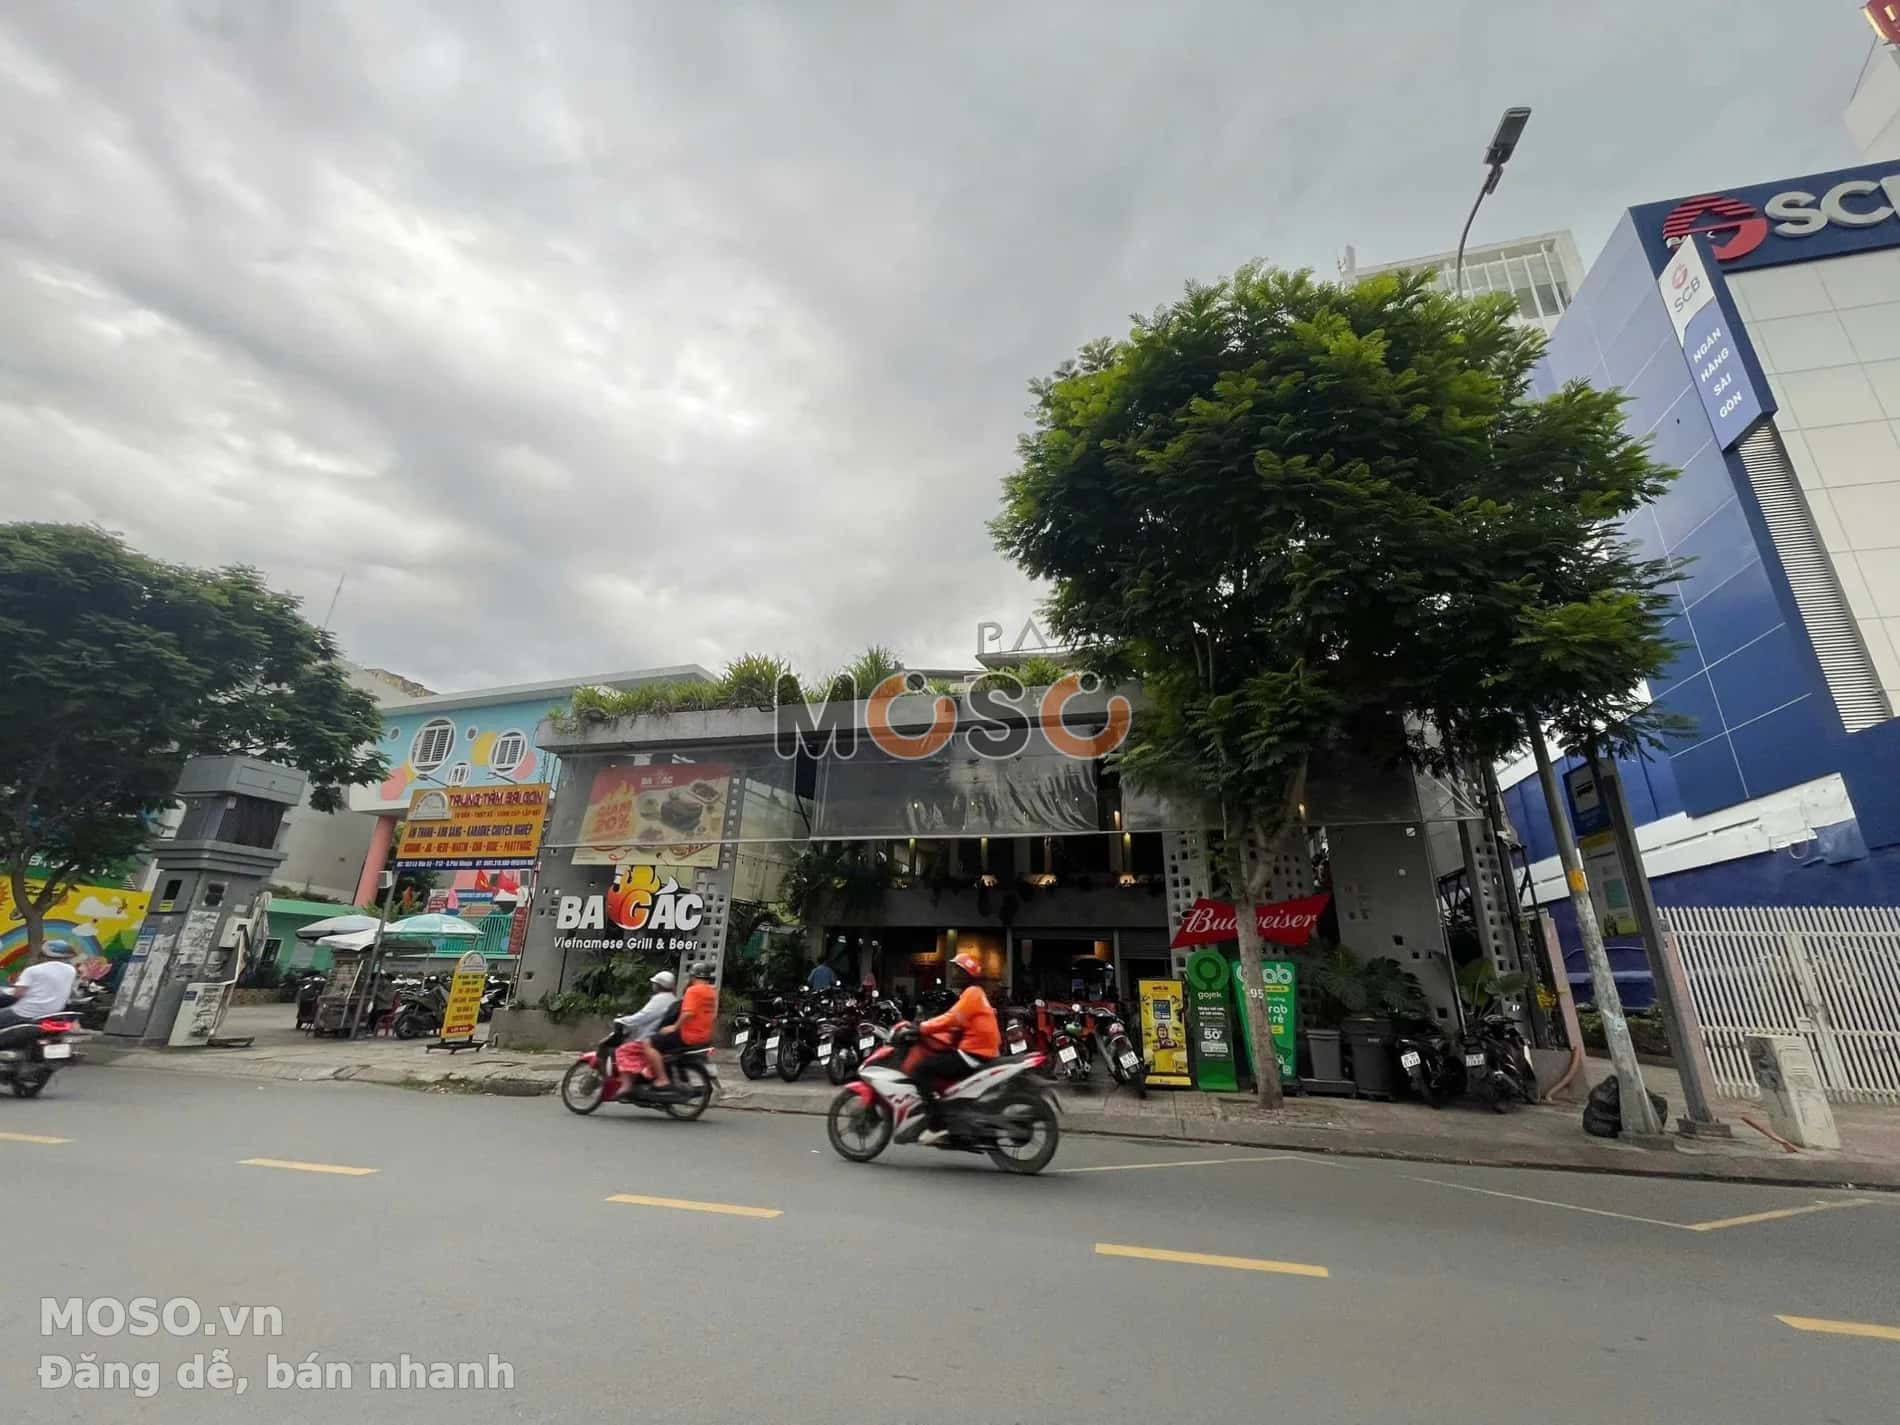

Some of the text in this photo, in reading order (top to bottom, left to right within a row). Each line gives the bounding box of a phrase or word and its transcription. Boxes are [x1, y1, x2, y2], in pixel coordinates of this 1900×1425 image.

[1674, 277, 1701, 312] SCB
[556, 895, 605, 929] BA
[1180, 907, 1317, 933] Bueiser
[554, 937, 698, 950] Vietnamese Grill & Beer
[1197, 991, 1221, 1000] gojek
